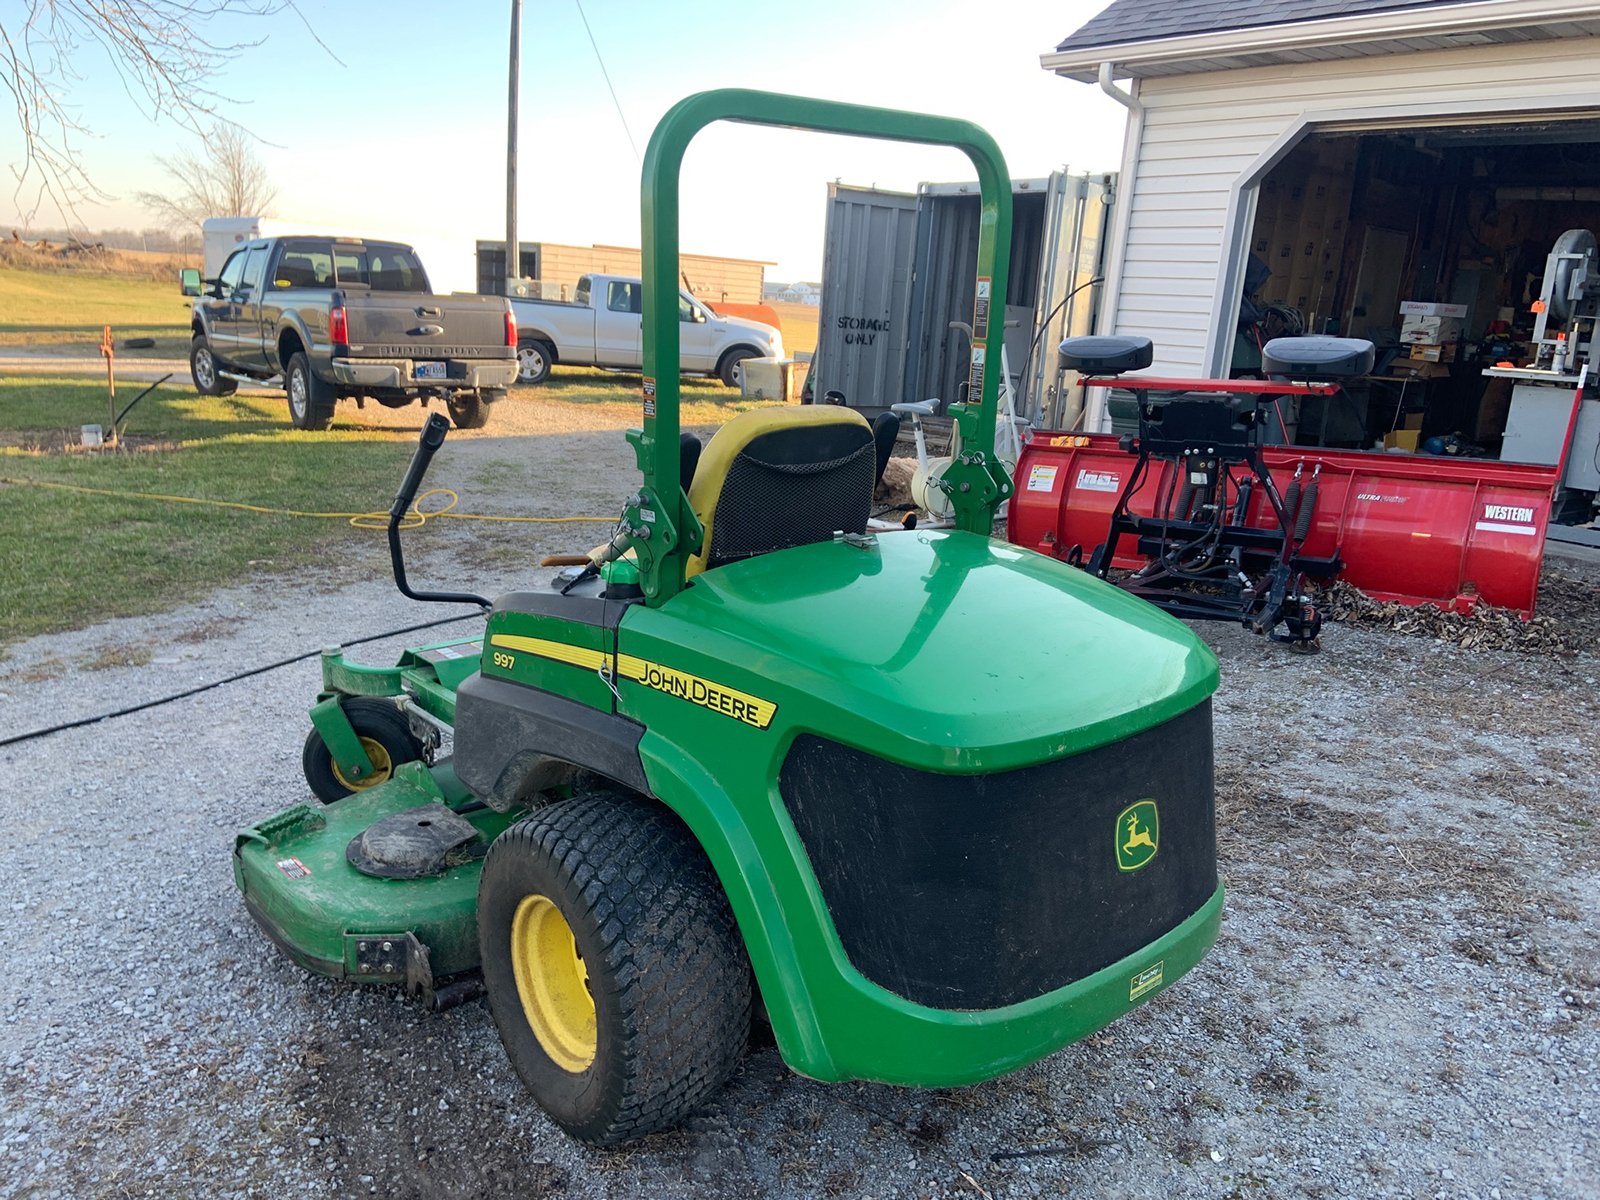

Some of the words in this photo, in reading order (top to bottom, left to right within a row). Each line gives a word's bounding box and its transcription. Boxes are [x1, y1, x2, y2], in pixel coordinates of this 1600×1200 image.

[837, 316, 890, 331] STORAGE
[845, 333, 876, 346] ONLY
[379, 346, 433, 356] SUPER
[442, 347, 482, 356] DUTY
[1484, 504, 1533, 522] WESTERN
[493, 651, 515, 670] 997
[638, 663, 688, 697] JOHN
[692, 679, 759, 723] DEERE
